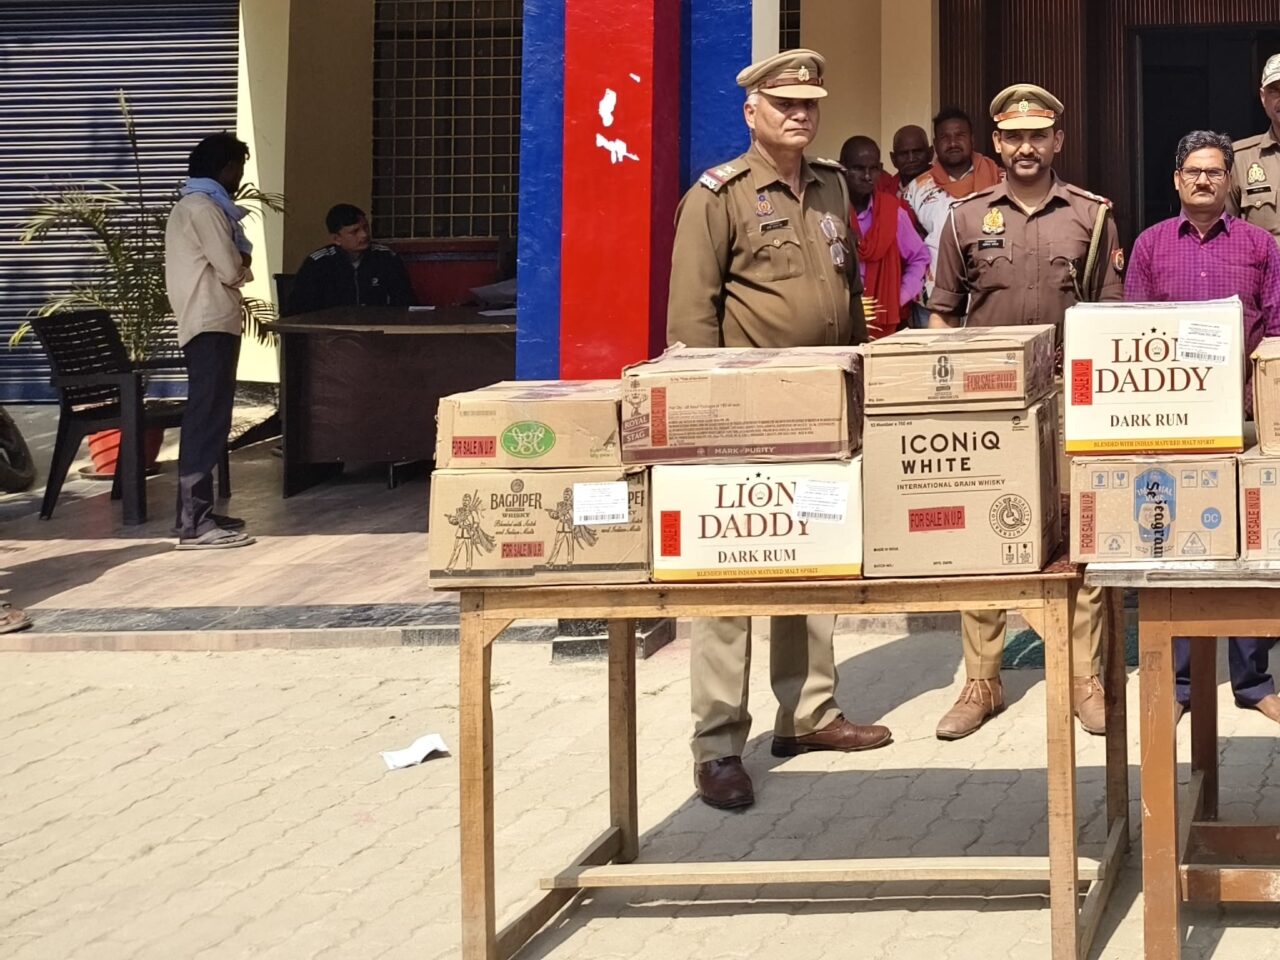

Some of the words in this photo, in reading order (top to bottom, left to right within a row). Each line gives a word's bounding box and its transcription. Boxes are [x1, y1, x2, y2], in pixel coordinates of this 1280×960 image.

[1111, 337, 1181, 363] LIO
[1094, 366, 1214, 394] DADDY
[624, 416, 647, 429] ROYAL
[1110, 414, 1151, 427] DARK
[1155, 413, 1189, 427] RUM
[626, 429, 645, 442] STAG
[463, 440, 477, 455] SALE
[901, 457, 971, 475] WHITE
[897, 482, 952, 490] INTERNATIONAL
[953, 480, 976, 488] GRAIN
[490, 492, 542, 510] BAGPIPER
[715, 481, 797, 509] LION
[698, 512, 810, 539] DADDY
[909, 513, 925, 529] FOR
[926, 512, 942, 527] SALE
[1082, 514, 1094, 533] SALE
[1202, 513, 1219, 523] DC
[1248, 510, 1260, 529] SALE
[1082, 533, 1094, 548] FOR
[1248, 529, 1260, 545] FOR
[718, 550, 759, 563] DARK
[763, 549, 796, 562] RUM
